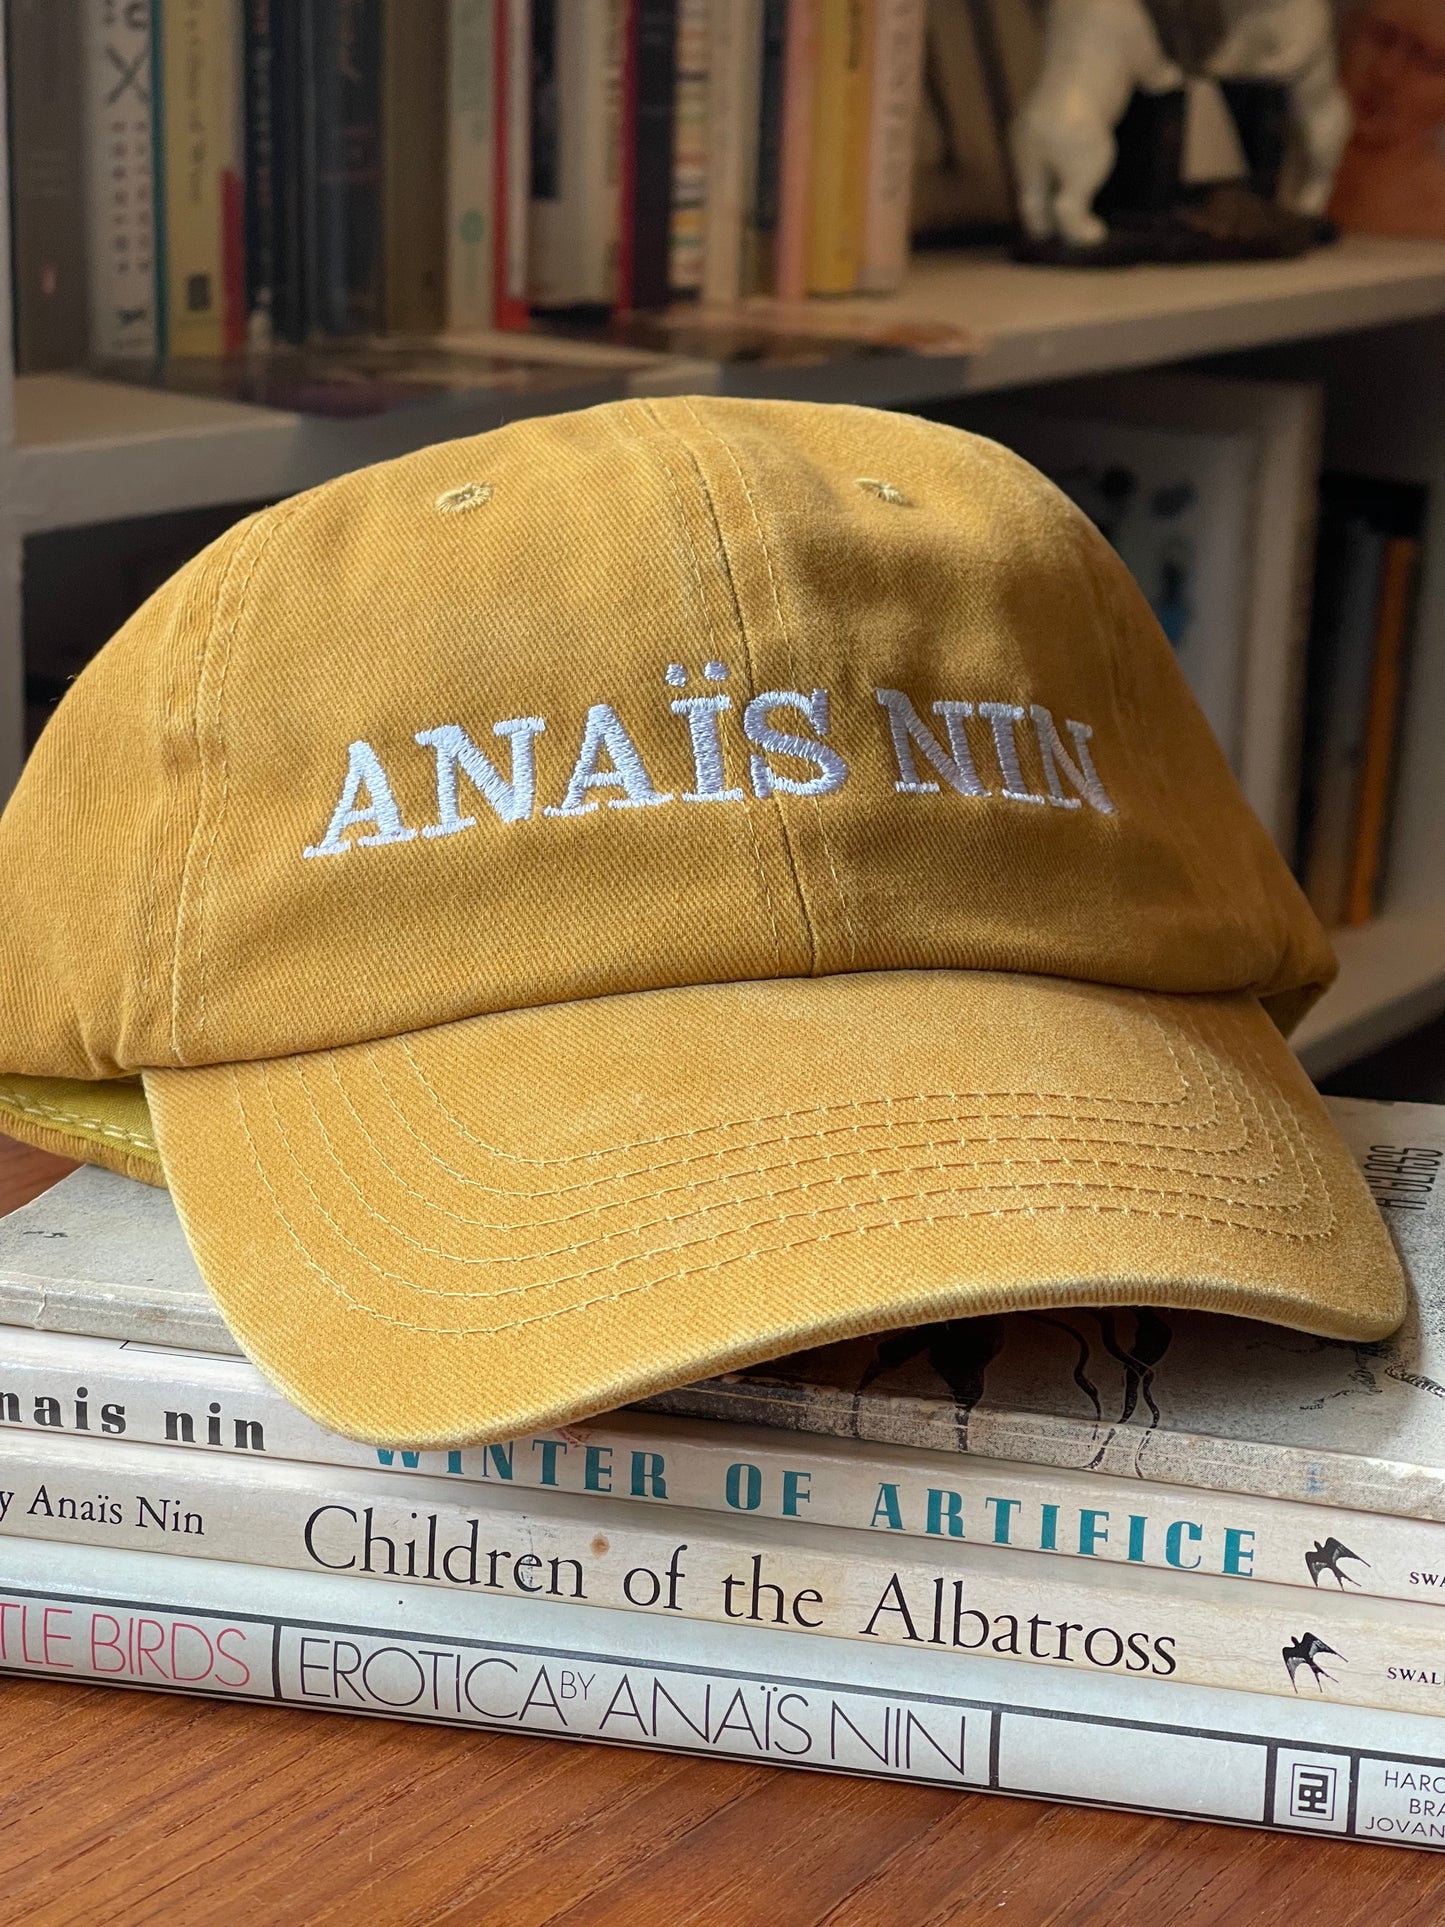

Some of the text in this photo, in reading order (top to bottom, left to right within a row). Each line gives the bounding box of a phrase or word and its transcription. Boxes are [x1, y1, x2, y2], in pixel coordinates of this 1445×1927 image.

[303, 661, 1116, 858] ANAÏS NIN
[1364, 1145, 1444, 1193] GLASS
[0, 1386, 266, 1451] nais nin
[27, 1484, 123, 1525] Anaïs
[135, 1495, 205, 1535] Nin
[725, 1462, 812, 1517] OF
[870, 1482, 1256, 1578] ARTIFICE
[304, 1505, 1178, 1676] Children of the Albatross
[0, 1602, 251, 1688] TLE BIRDS
[1387, 1667, 1445, 1686] SWAL
[300, 1636, 966, 1776] EROTICA BY ANAÏS NIN
[1365, 1816, 1445, 1839] JOVAN
